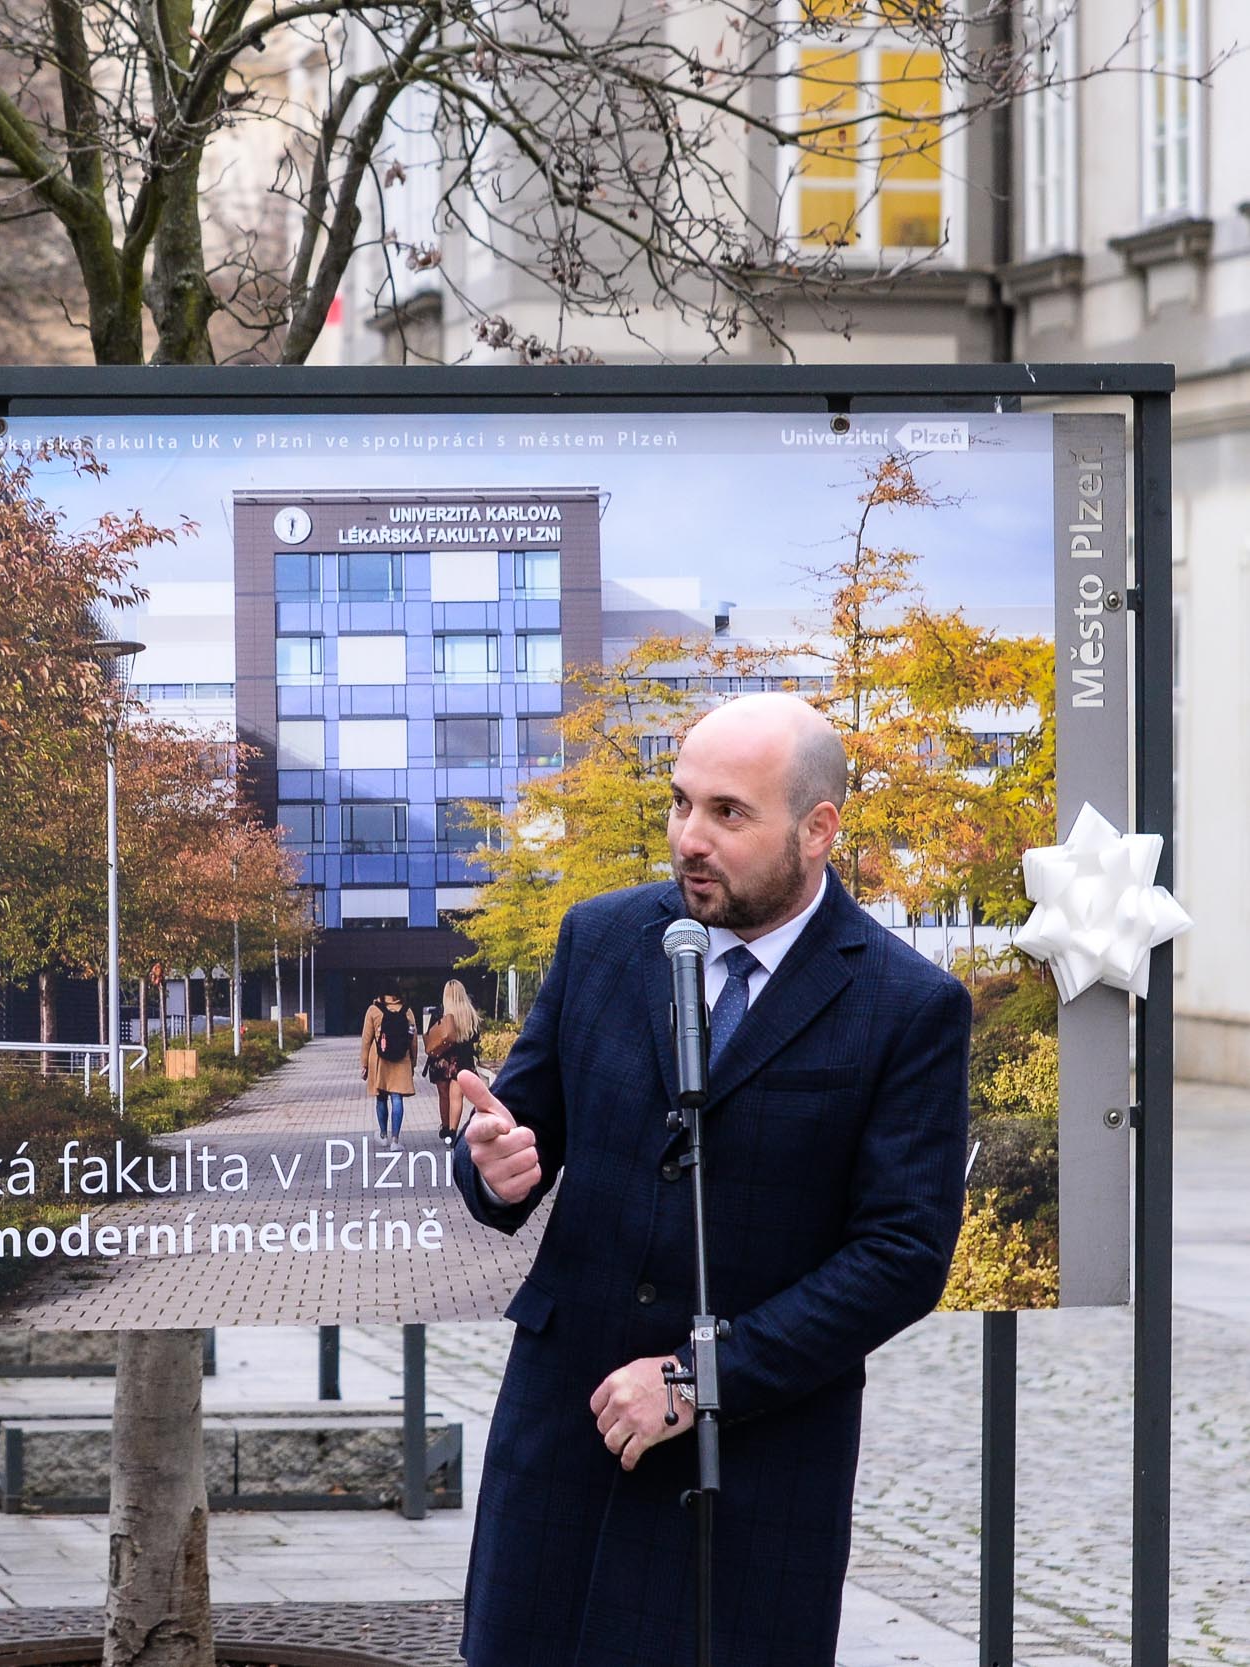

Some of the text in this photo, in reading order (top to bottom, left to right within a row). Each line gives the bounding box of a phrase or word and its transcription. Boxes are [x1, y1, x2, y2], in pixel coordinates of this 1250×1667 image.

[96, 433, 178, 450] fakulta
[192, 433, 221, 449] UK
[233, 437, 243, 449] v
[256, 433, 312, 449] Plzni
[325, 437, 349, 448] ve
[362, 431, 484, 452] spolupráci
[497, 436, 506, 447] s
[519, 431, 604, 448] městem
[618, 430, 678, 447] Plzeň
[781, 428, 962, 447] Univerzitní Plzeň
[389, 505, 561, 523] UNIVERZITA KARLOVA
[338, 524, 561, 544] LÉKAŘSKÁ FAKULTA V PLZNI
[1069, 447, 1105, 708] Město Plzeň
[57, 1138, 250, 1195] fakulta
[270, 1151, 302, 1191] v
[325, 1135, 453, 1190] Plzni
[210, 1208, 443, 1254] medicíně
